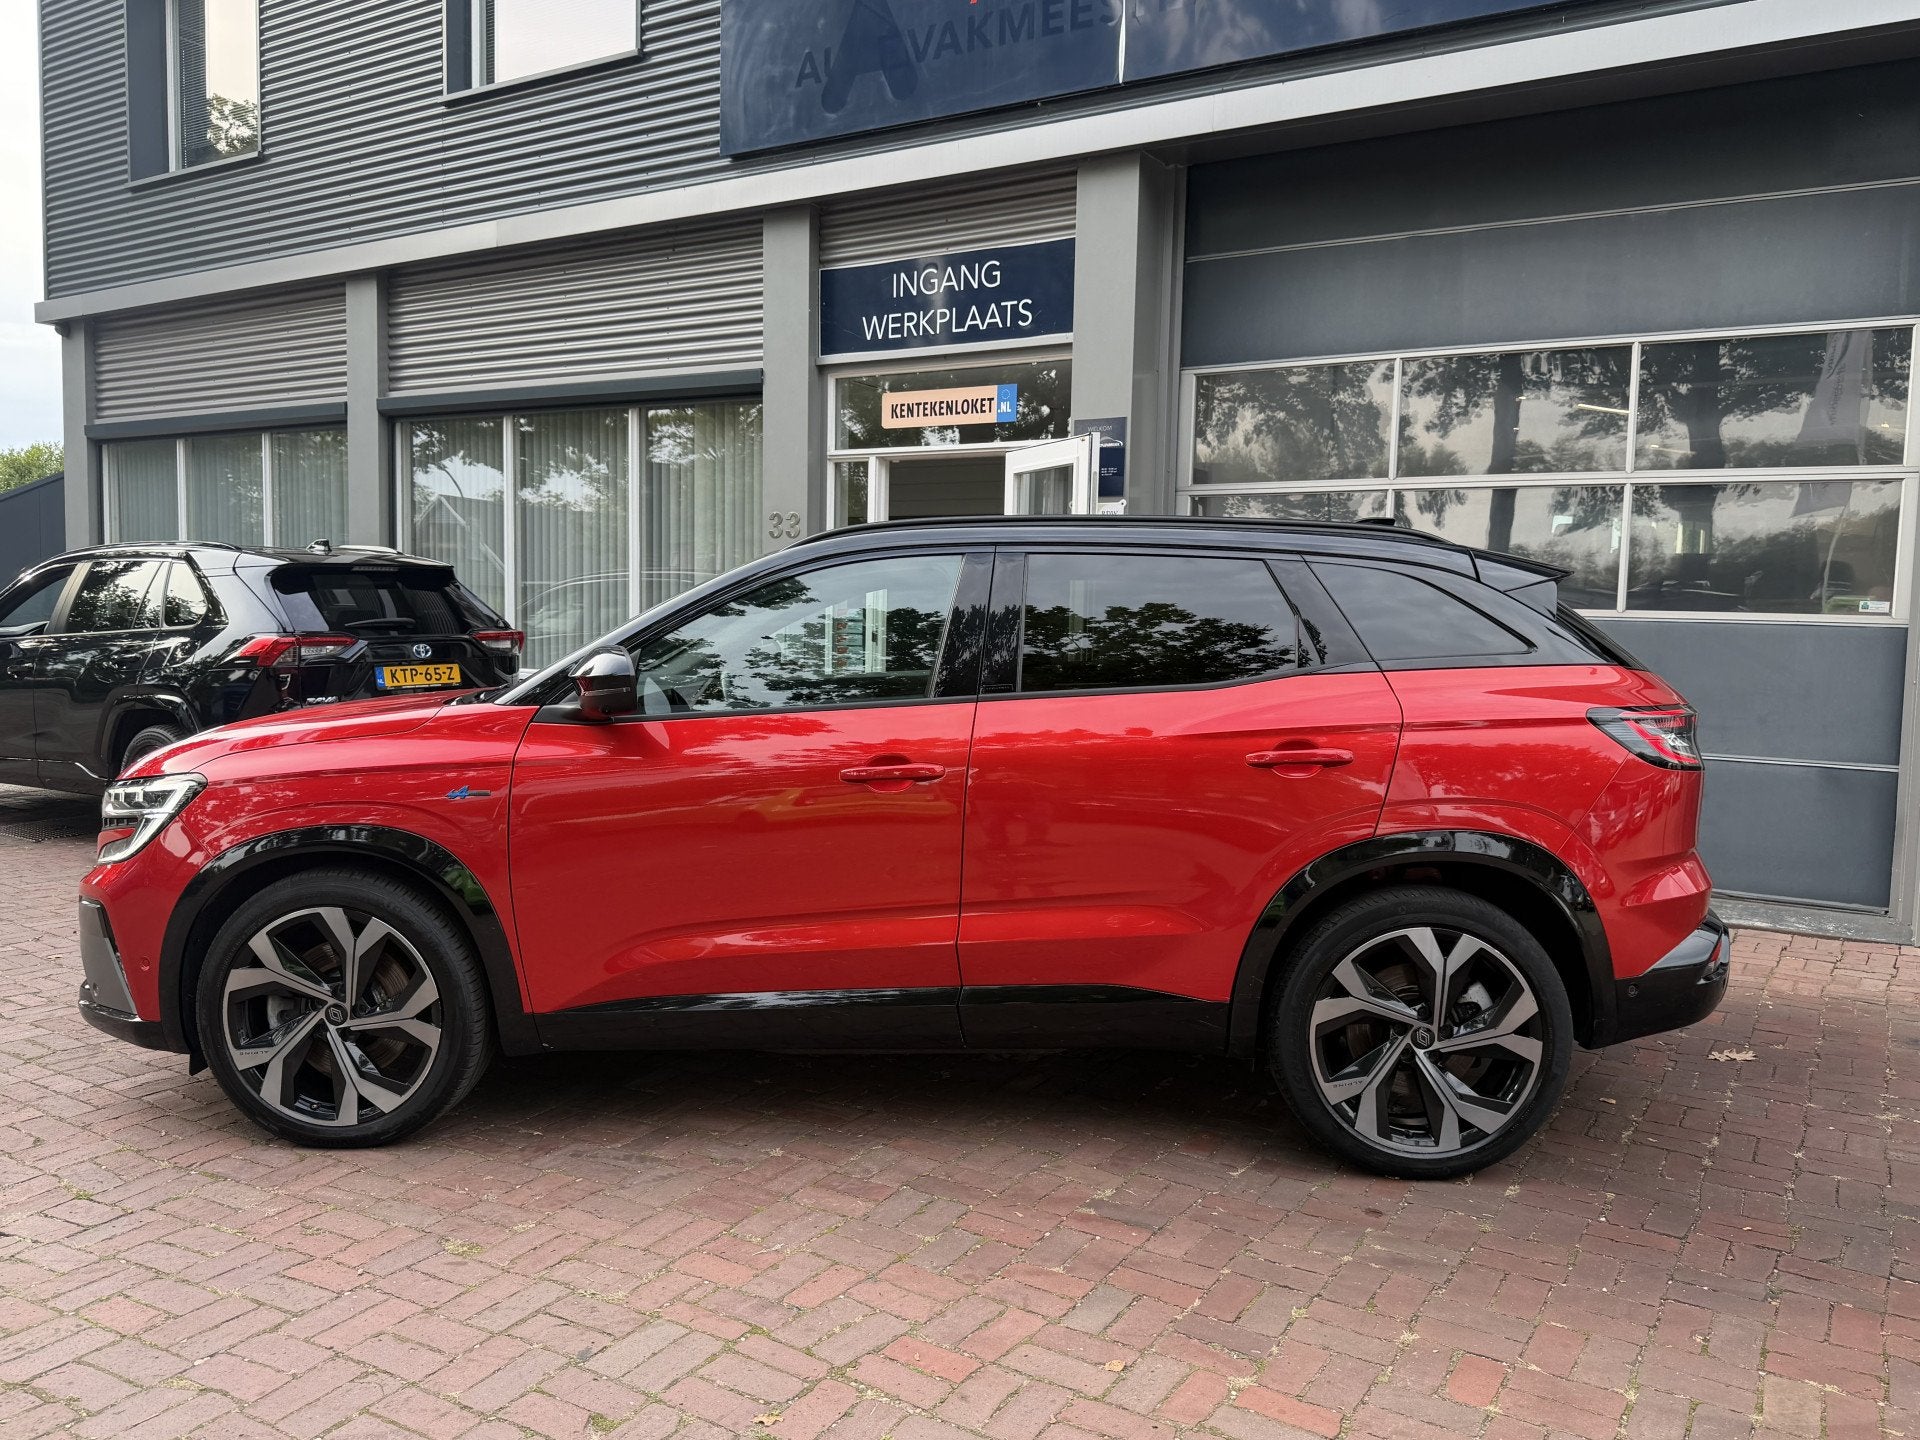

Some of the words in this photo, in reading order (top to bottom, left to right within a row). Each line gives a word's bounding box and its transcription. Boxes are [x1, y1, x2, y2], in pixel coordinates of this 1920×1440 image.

[892, 260, 1001, 298] INGANG
[862, 298, 1033, 341] WERKPLAATS
[890, 397, 995, 419] KENTEKENLOKET
[768, 511, 801, 539] 33
[389, 666, 455, 684] KTP-65-Z
